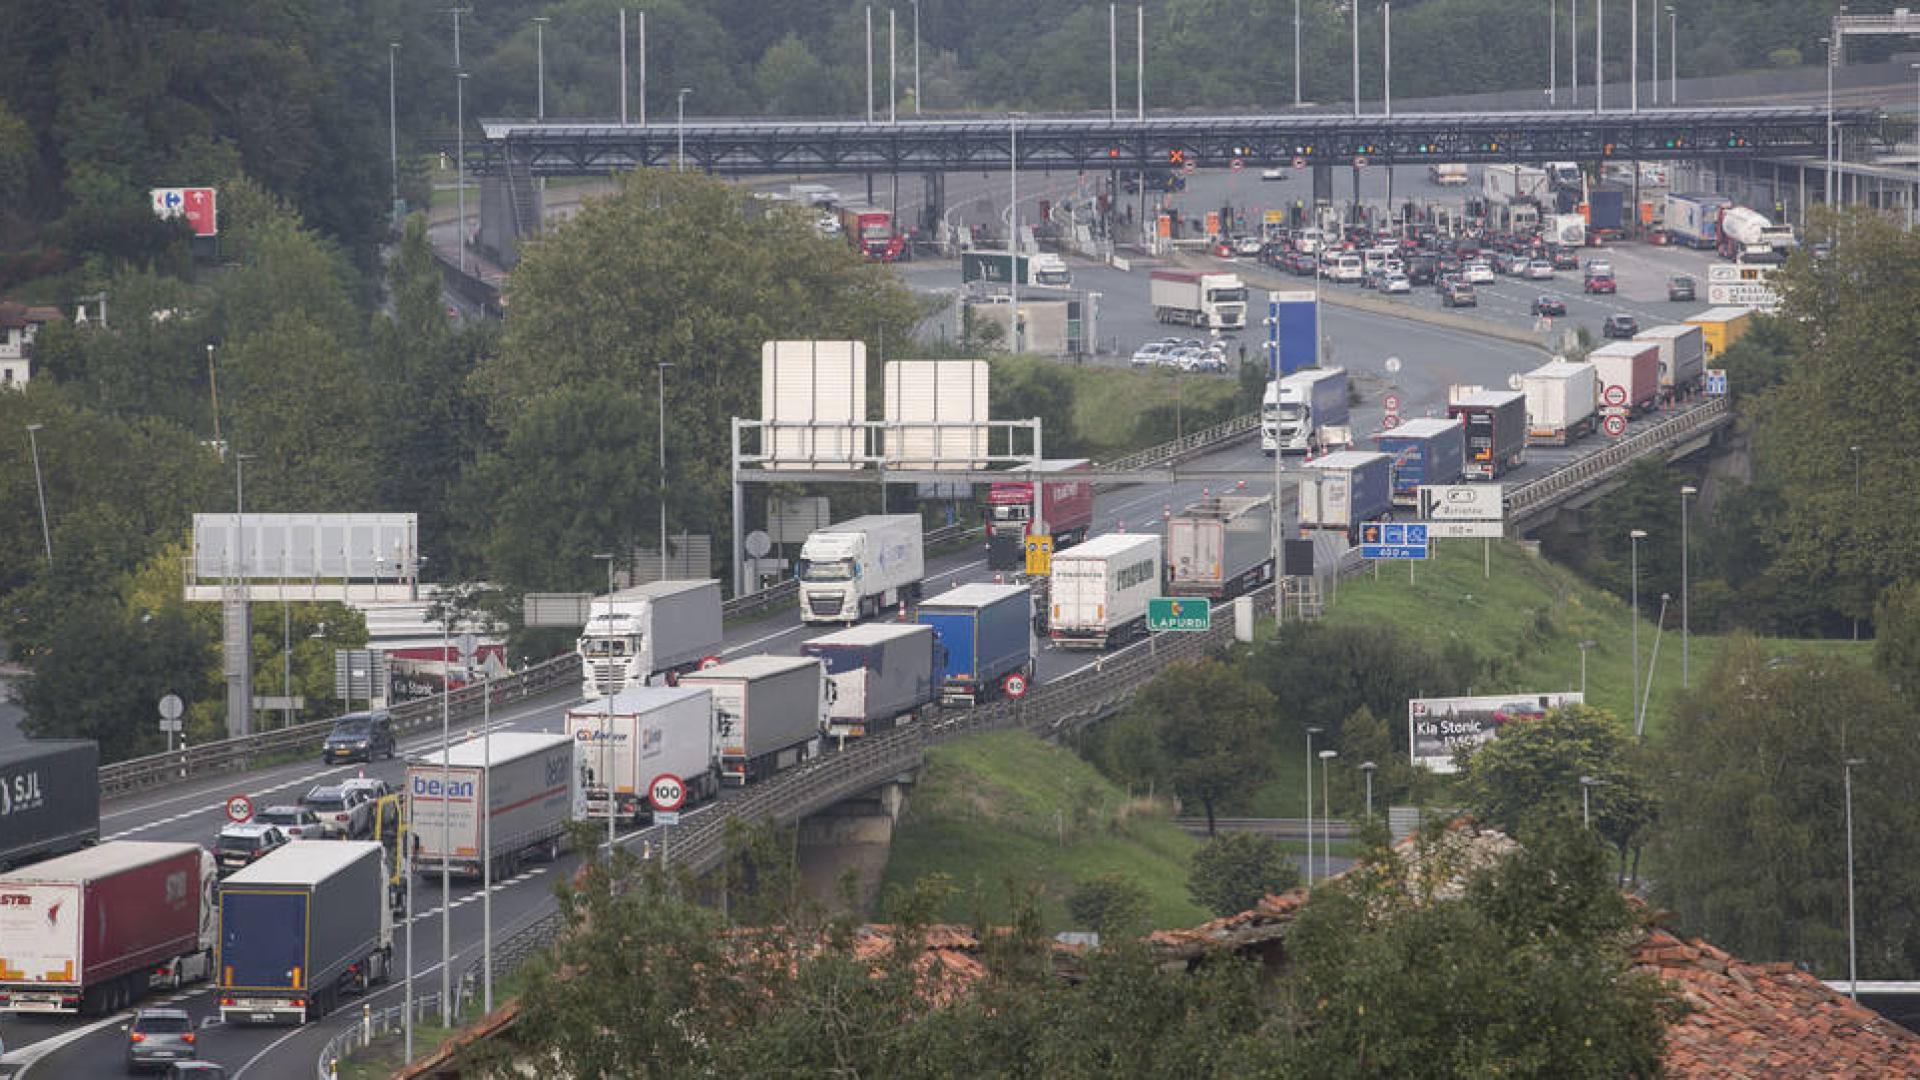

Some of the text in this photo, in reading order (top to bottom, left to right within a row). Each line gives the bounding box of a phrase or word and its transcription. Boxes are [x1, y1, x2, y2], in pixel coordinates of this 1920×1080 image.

[1610, 420, 1621, 430] 70
[1151, 617, 1207, 629] LAPURDI
[1417, 718, 1482, 735] Kia Stonic
[15, 771, 41, 802] SJL
[656, 786, 681, 800] 100
[231, 803, 248, 814] 100
